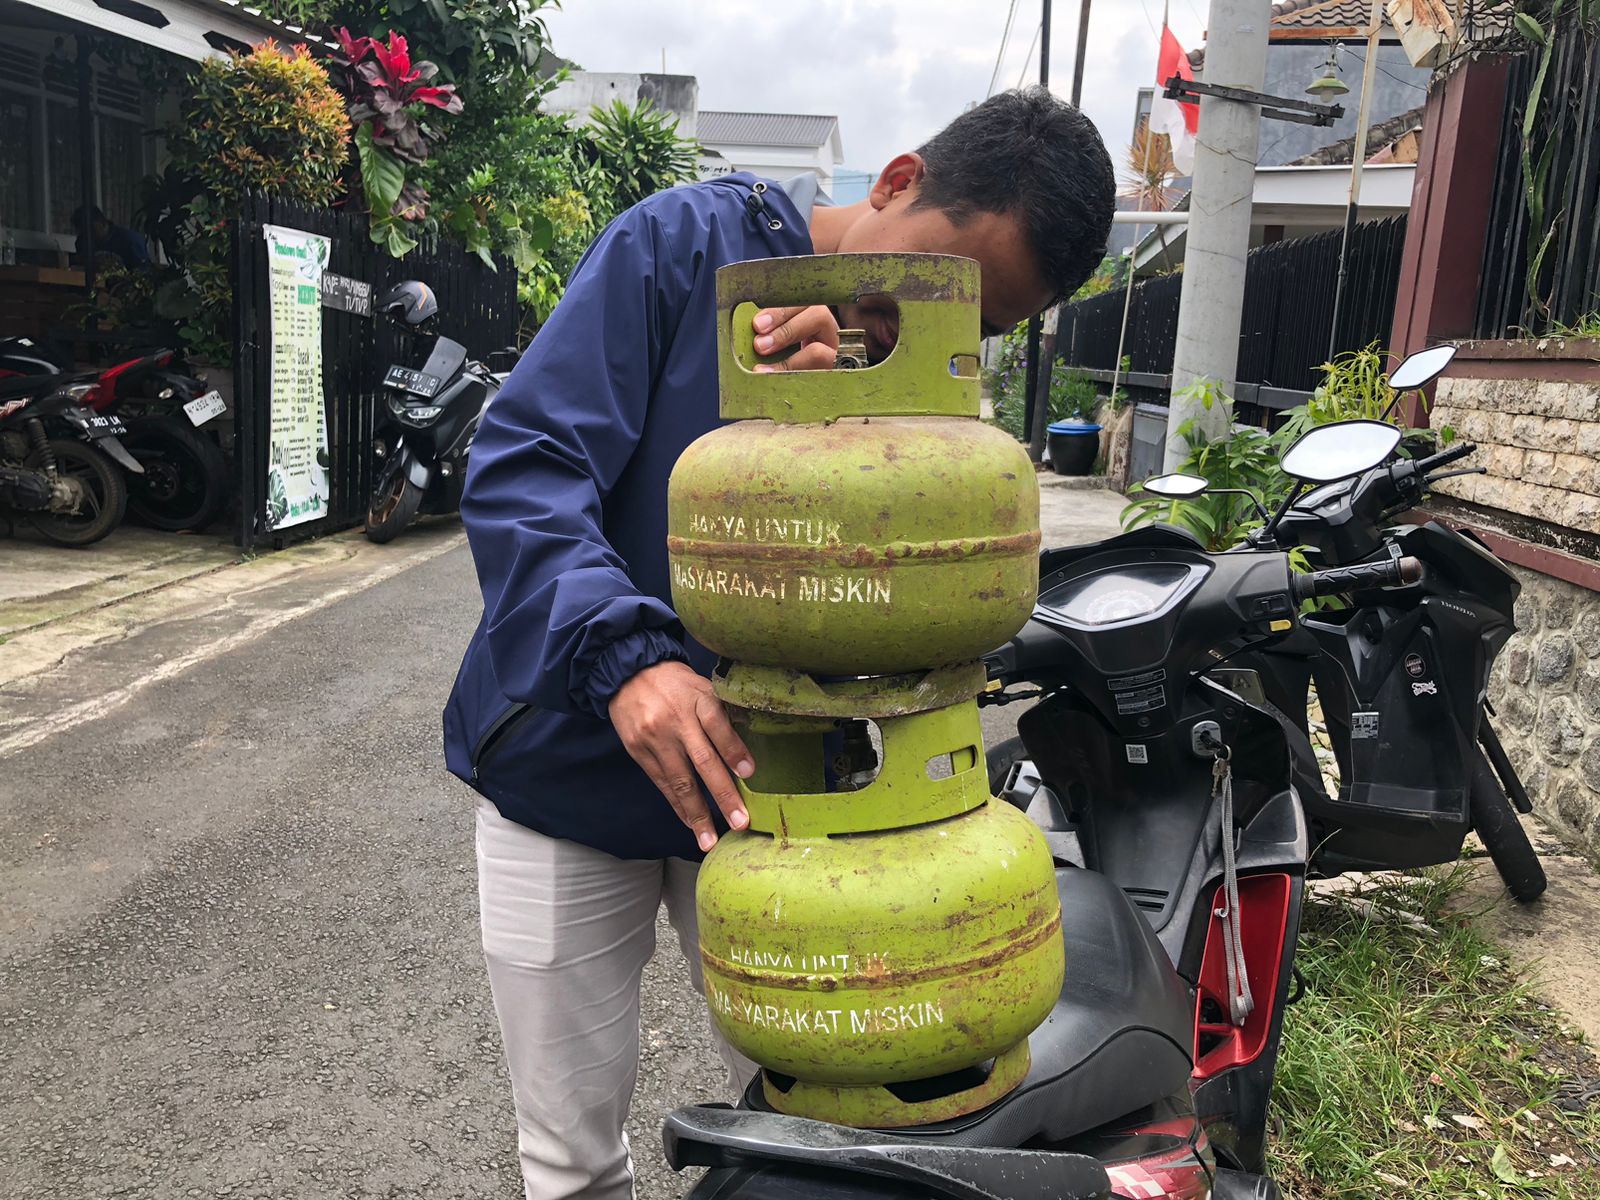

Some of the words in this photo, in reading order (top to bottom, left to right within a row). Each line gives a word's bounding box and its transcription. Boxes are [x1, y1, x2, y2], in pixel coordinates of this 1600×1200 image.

[392, 369, 403, 378] AE
[755, 519, 842, 547] UNTUK
[799, 573, 892, 604] MISKIN
[850, 1001, 945, 1035] MISKIN
